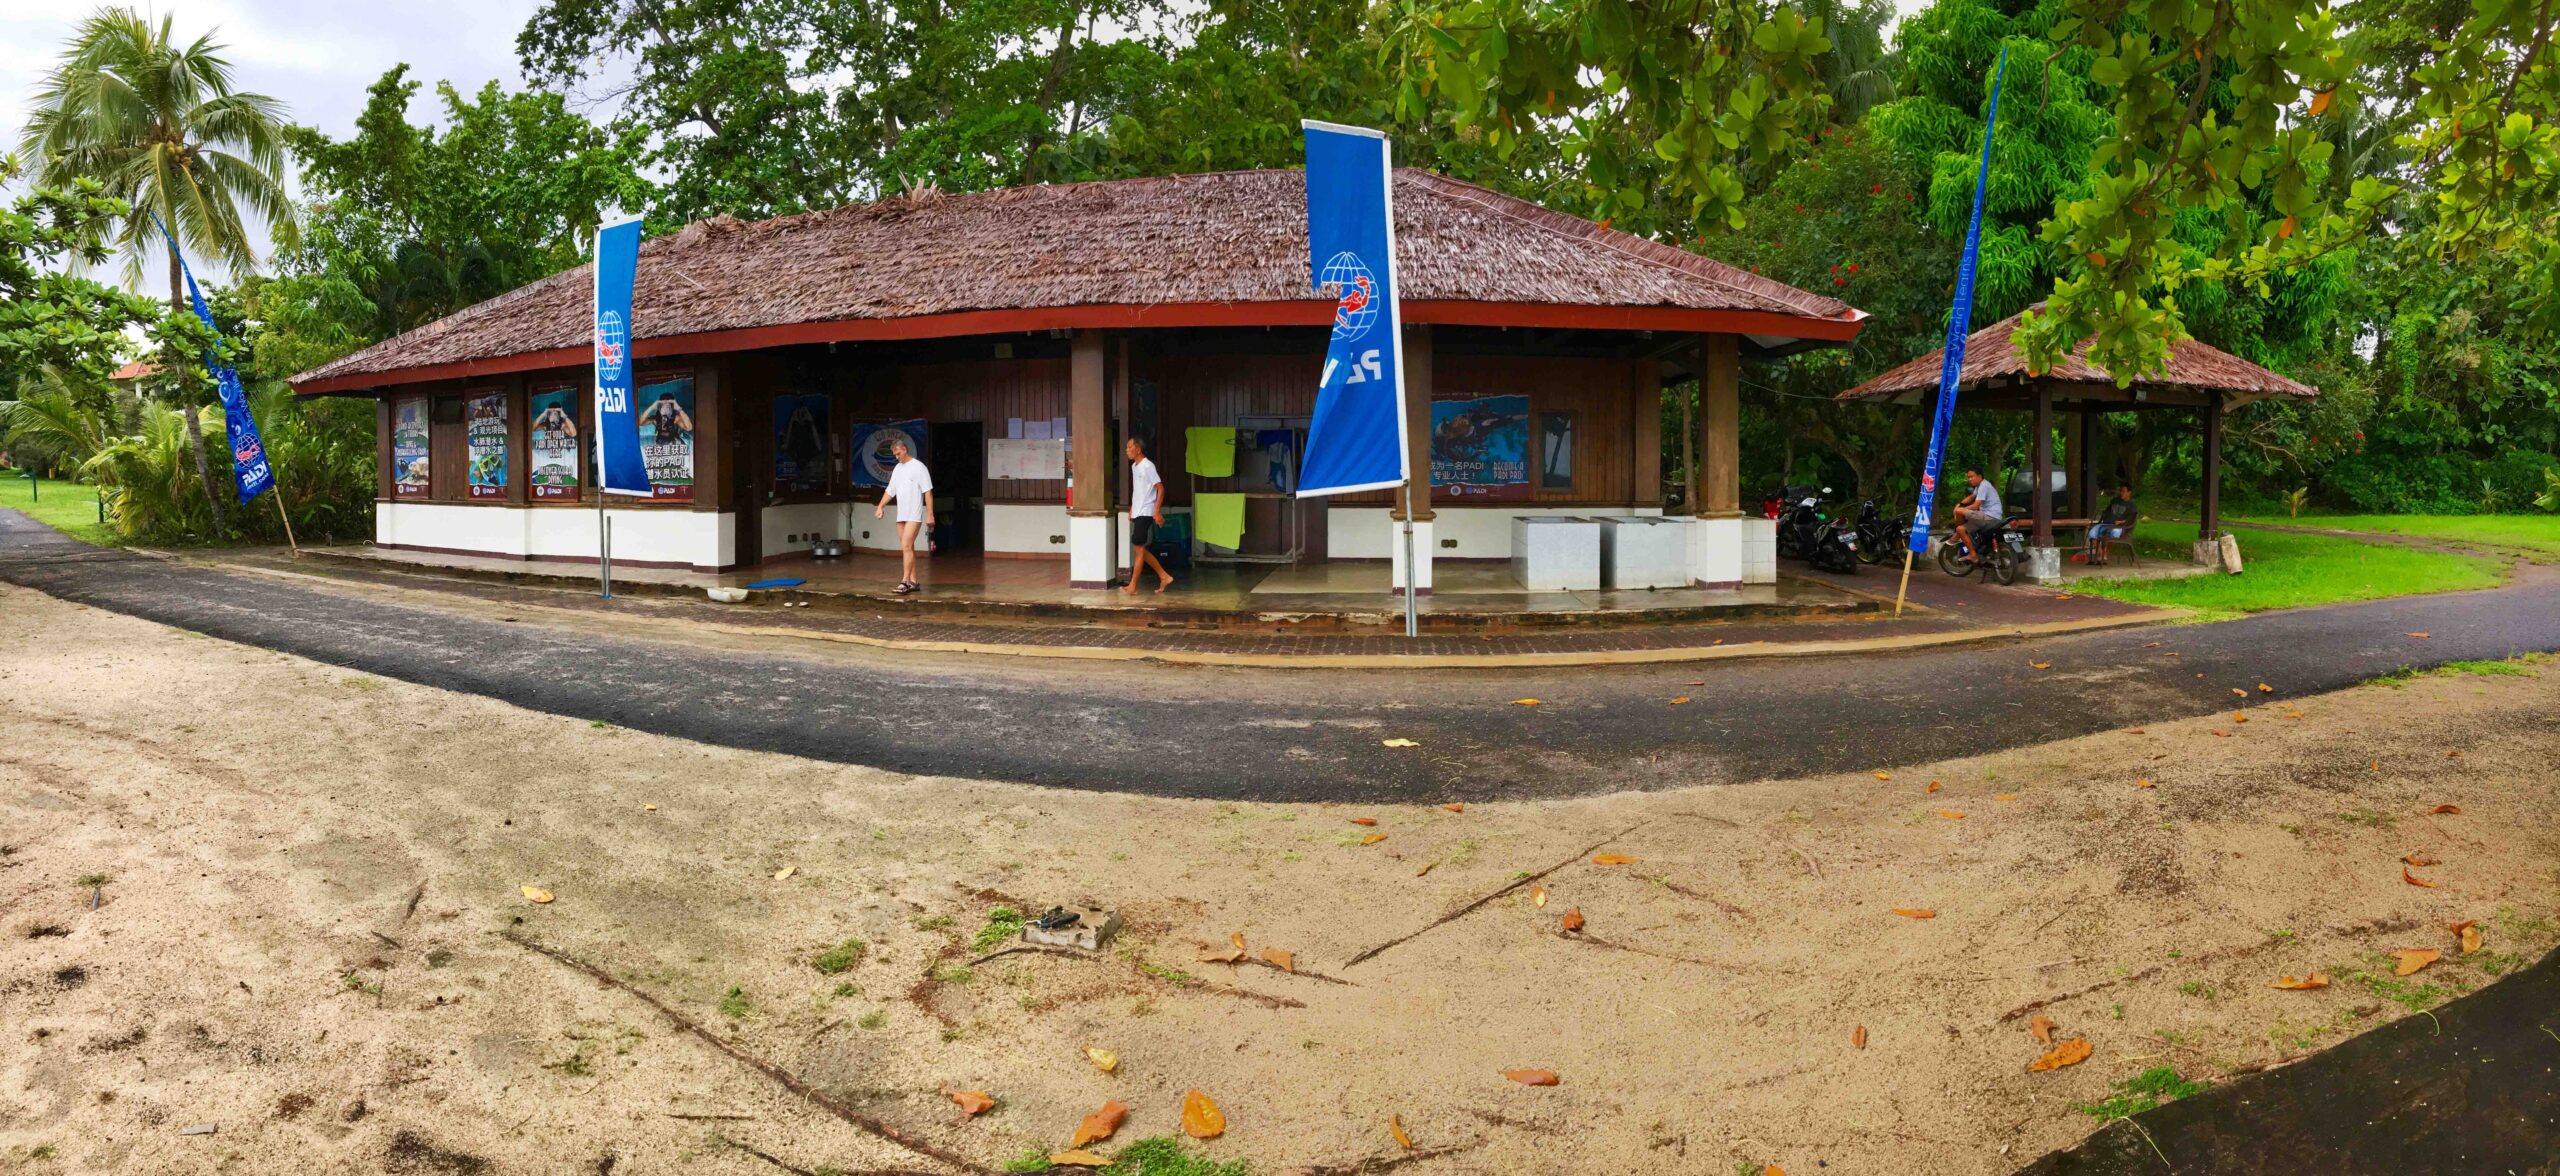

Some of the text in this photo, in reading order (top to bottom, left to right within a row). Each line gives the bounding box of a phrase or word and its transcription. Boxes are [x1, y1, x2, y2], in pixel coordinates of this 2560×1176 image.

[598, 386, 627, 413] PADI
[645, 444, 689, 456] 在这里获取
[242, 461, 267, 487] PADI
